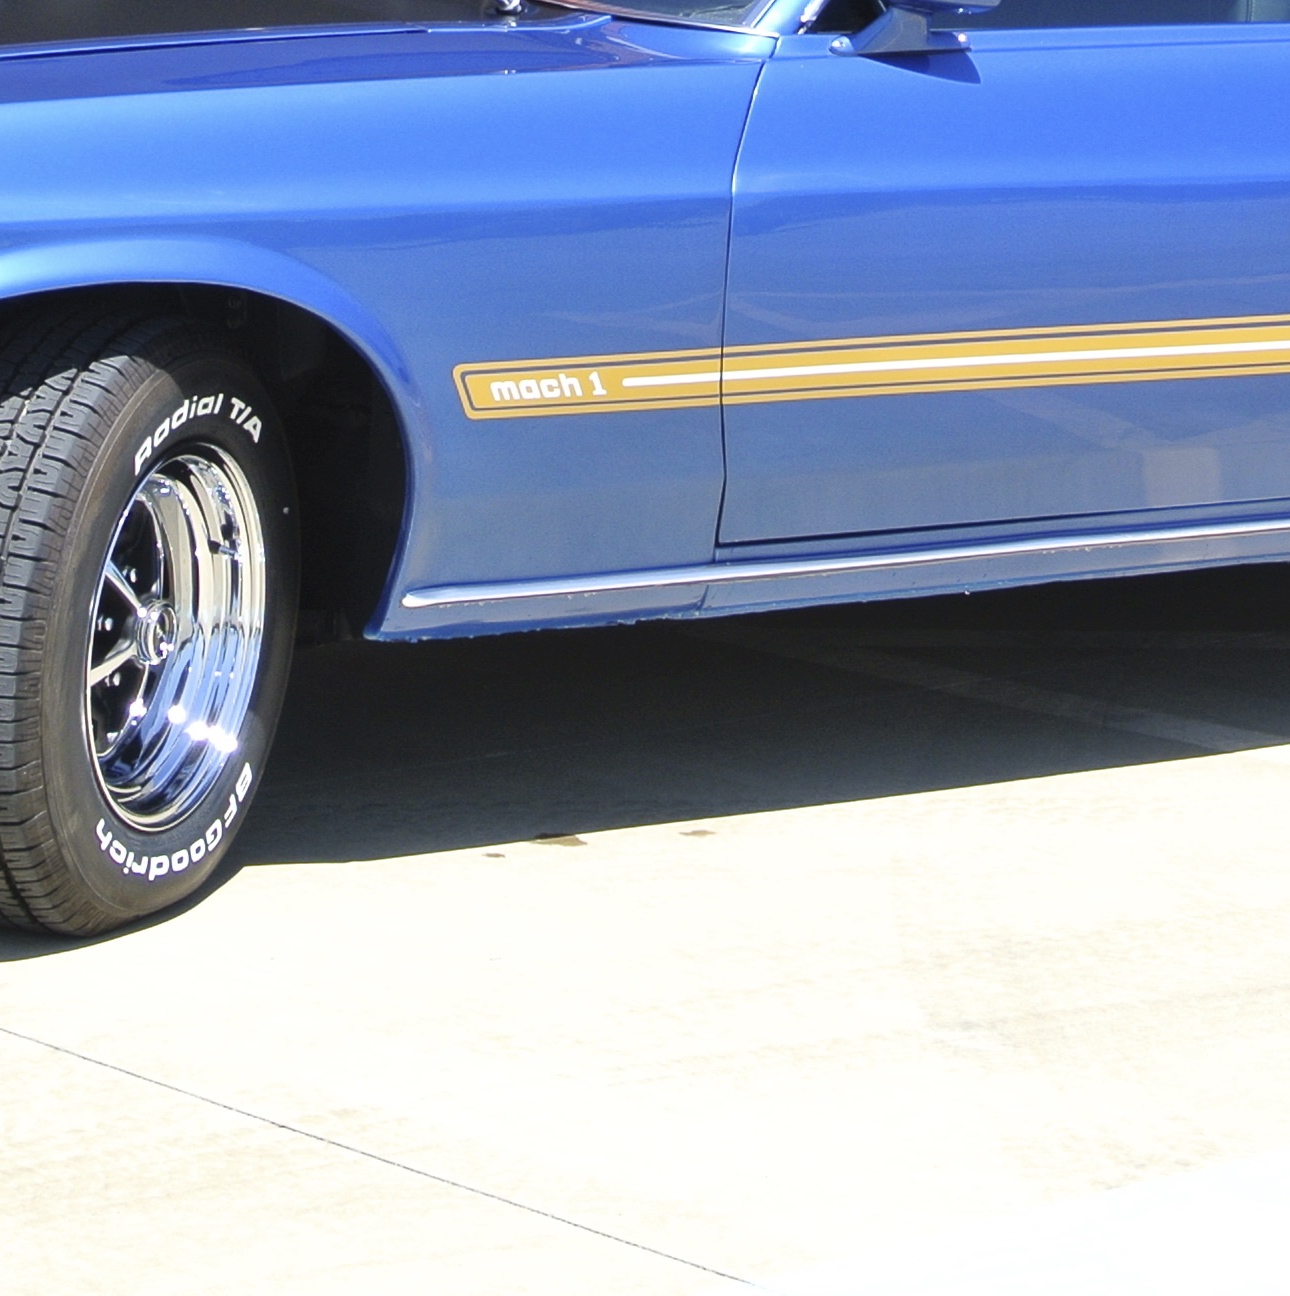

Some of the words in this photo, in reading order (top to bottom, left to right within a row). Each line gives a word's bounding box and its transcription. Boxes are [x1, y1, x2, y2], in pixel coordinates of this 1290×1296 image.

[489, 372, 583, 402] mach
[588, 371, 607, 397] 1
[133, 393, 224, 477] Radial
[229, 396, 263, 444] T/A
[95, 761, 253, 882] BFGoodrich
